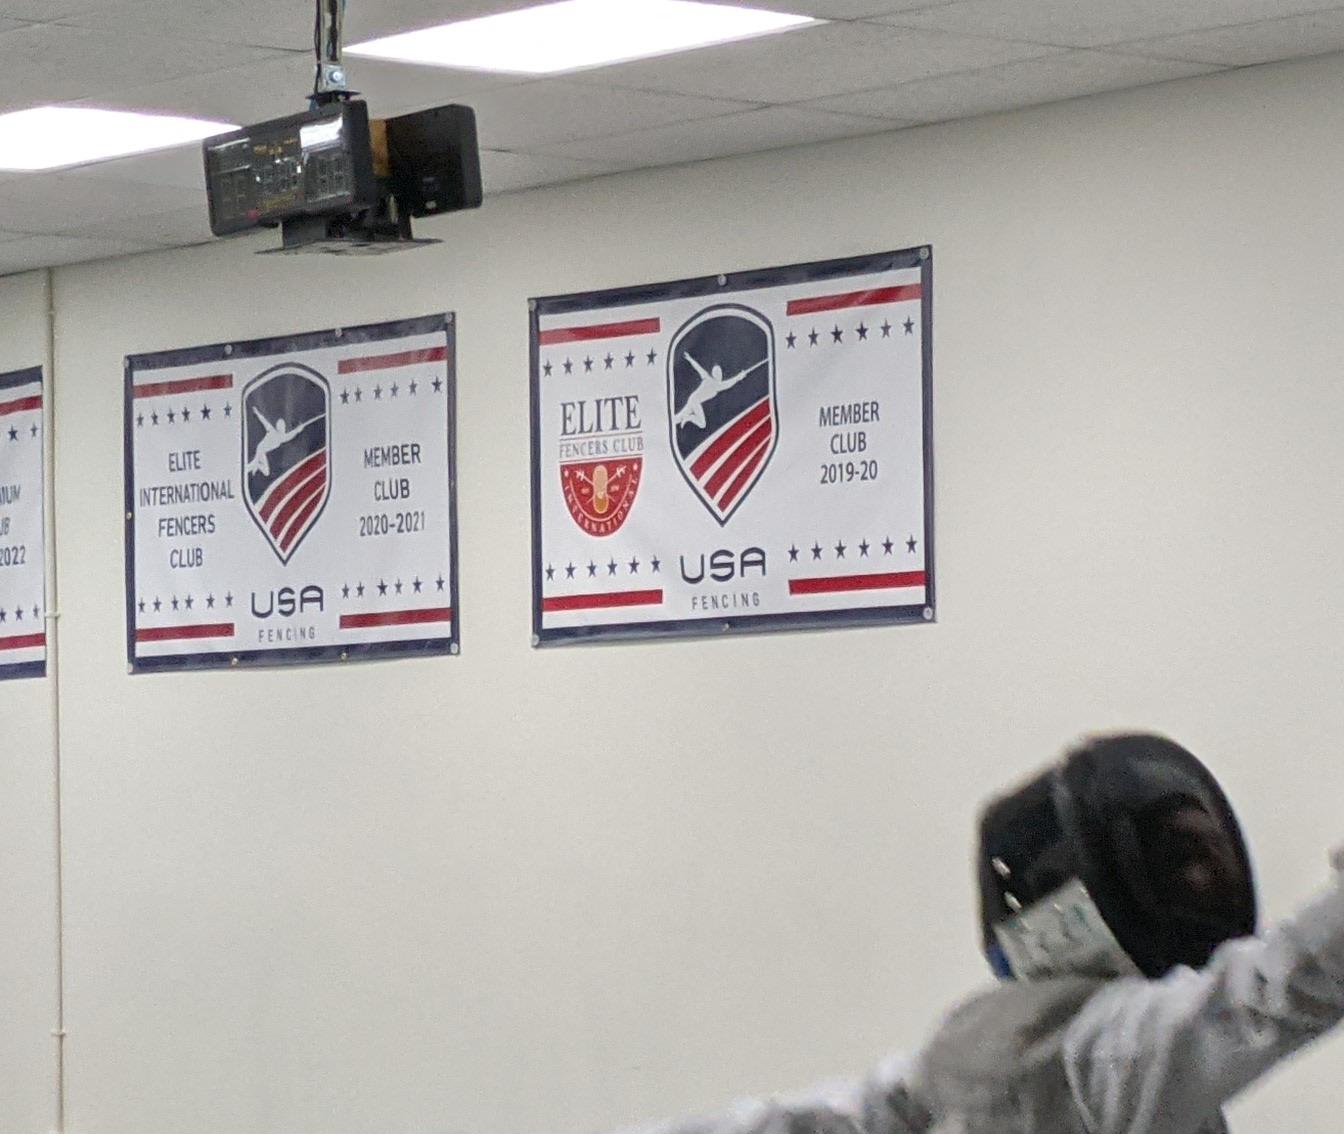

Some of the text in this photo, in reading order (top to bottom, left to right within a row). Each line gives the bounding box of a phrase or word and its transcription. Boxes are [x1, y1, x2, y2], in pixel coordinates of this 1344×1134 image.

[560, 395, 641, 436] ELITE
[819, 401, 880, 427] MEMBER
[559, 437, 645, 458] FENCERS CLUB
[830, 432, 867, 454] CLUB
[168, 450, 201, 472] ELITE
[364, 443, 421, 468] MEMBER
[820, 460, 878, 484] 2019-20
[140, 480, 234, 507] INTERNATIONAL
[374, 478, 411, 501] CLUB
[158, 514, 216, 537] FENCERS
[360, 511, 425, 537] 2020-2021
[170, 547, 204, 568] CLUB
[680, 547, 766, 584] USA
[251, 585, 324, 619] USA
[692, 592, 760, 610] FENCING
[258, 626, 315, 643] FENCING
